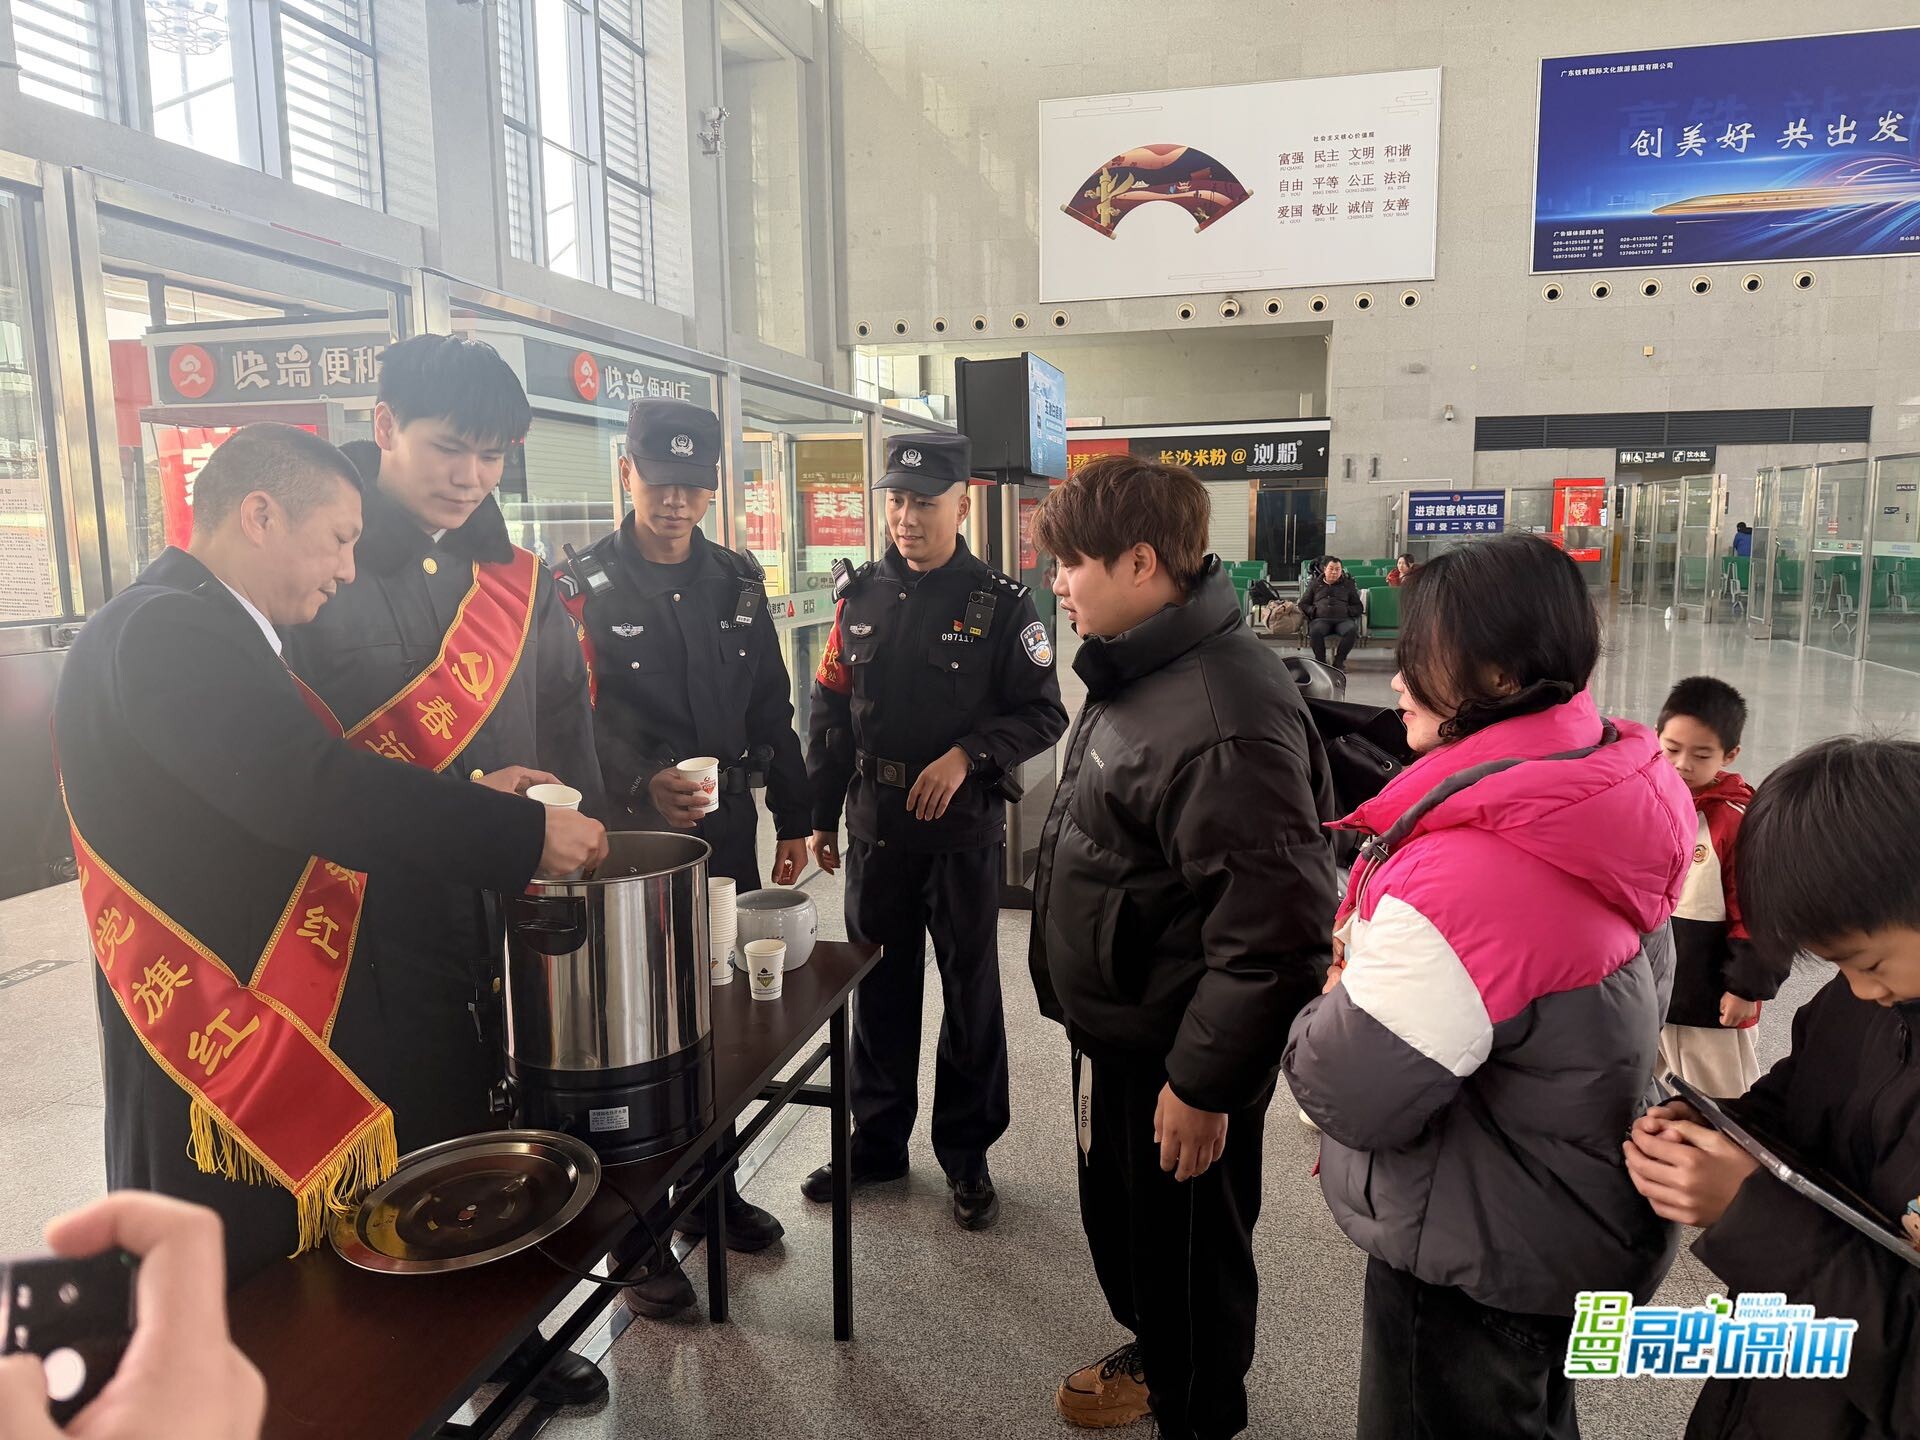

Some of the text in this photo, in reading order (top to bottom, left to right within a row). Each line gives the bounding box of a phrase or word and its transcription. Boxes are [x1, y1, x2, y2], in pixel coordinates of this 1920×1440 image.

[1313, 132, 1375, 142] 社会主义核心价值观
[1630, 110, 1909, 158] 创美好 共出发
[1278, 143, 1412, 166] 富强 民主 文明 和谐
[1280, 170, 1411, 192] 自由 平等 公正 法治
[1278, 197, 1410, 219] 爱国 敬业 诚信 友善
[1159, 448, 1227, 466] 长沙米粉
[1414, 504, 1498, 517] 进京旅客候车区域
[1414, 520, 1496, 531] 请接受二次安检
